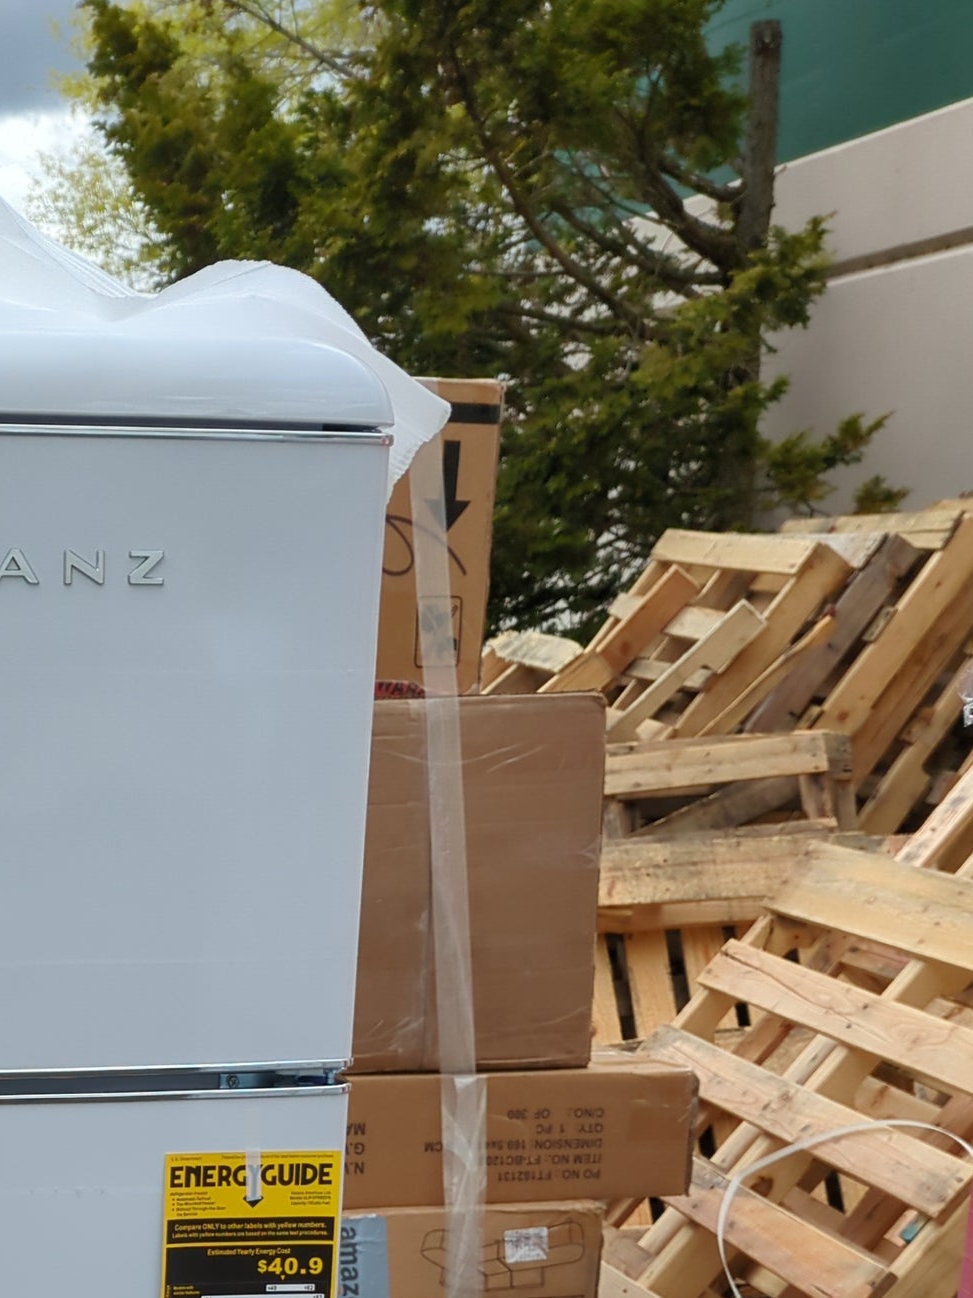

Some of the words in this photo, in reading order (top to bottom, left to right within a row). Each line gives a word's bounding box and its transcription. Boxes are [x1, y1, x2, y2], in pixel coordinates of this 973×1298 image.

[574, 1154, 602, 1165] ITEM
[203, 1223, 220, 1231] ONLY
[244, 1222, 263, 1230] labels
[278, 1221, 297, 1231] yellow
[255, 1248, 276, 1256] Energy
[257, 1257, 323, 1275] $40.9
